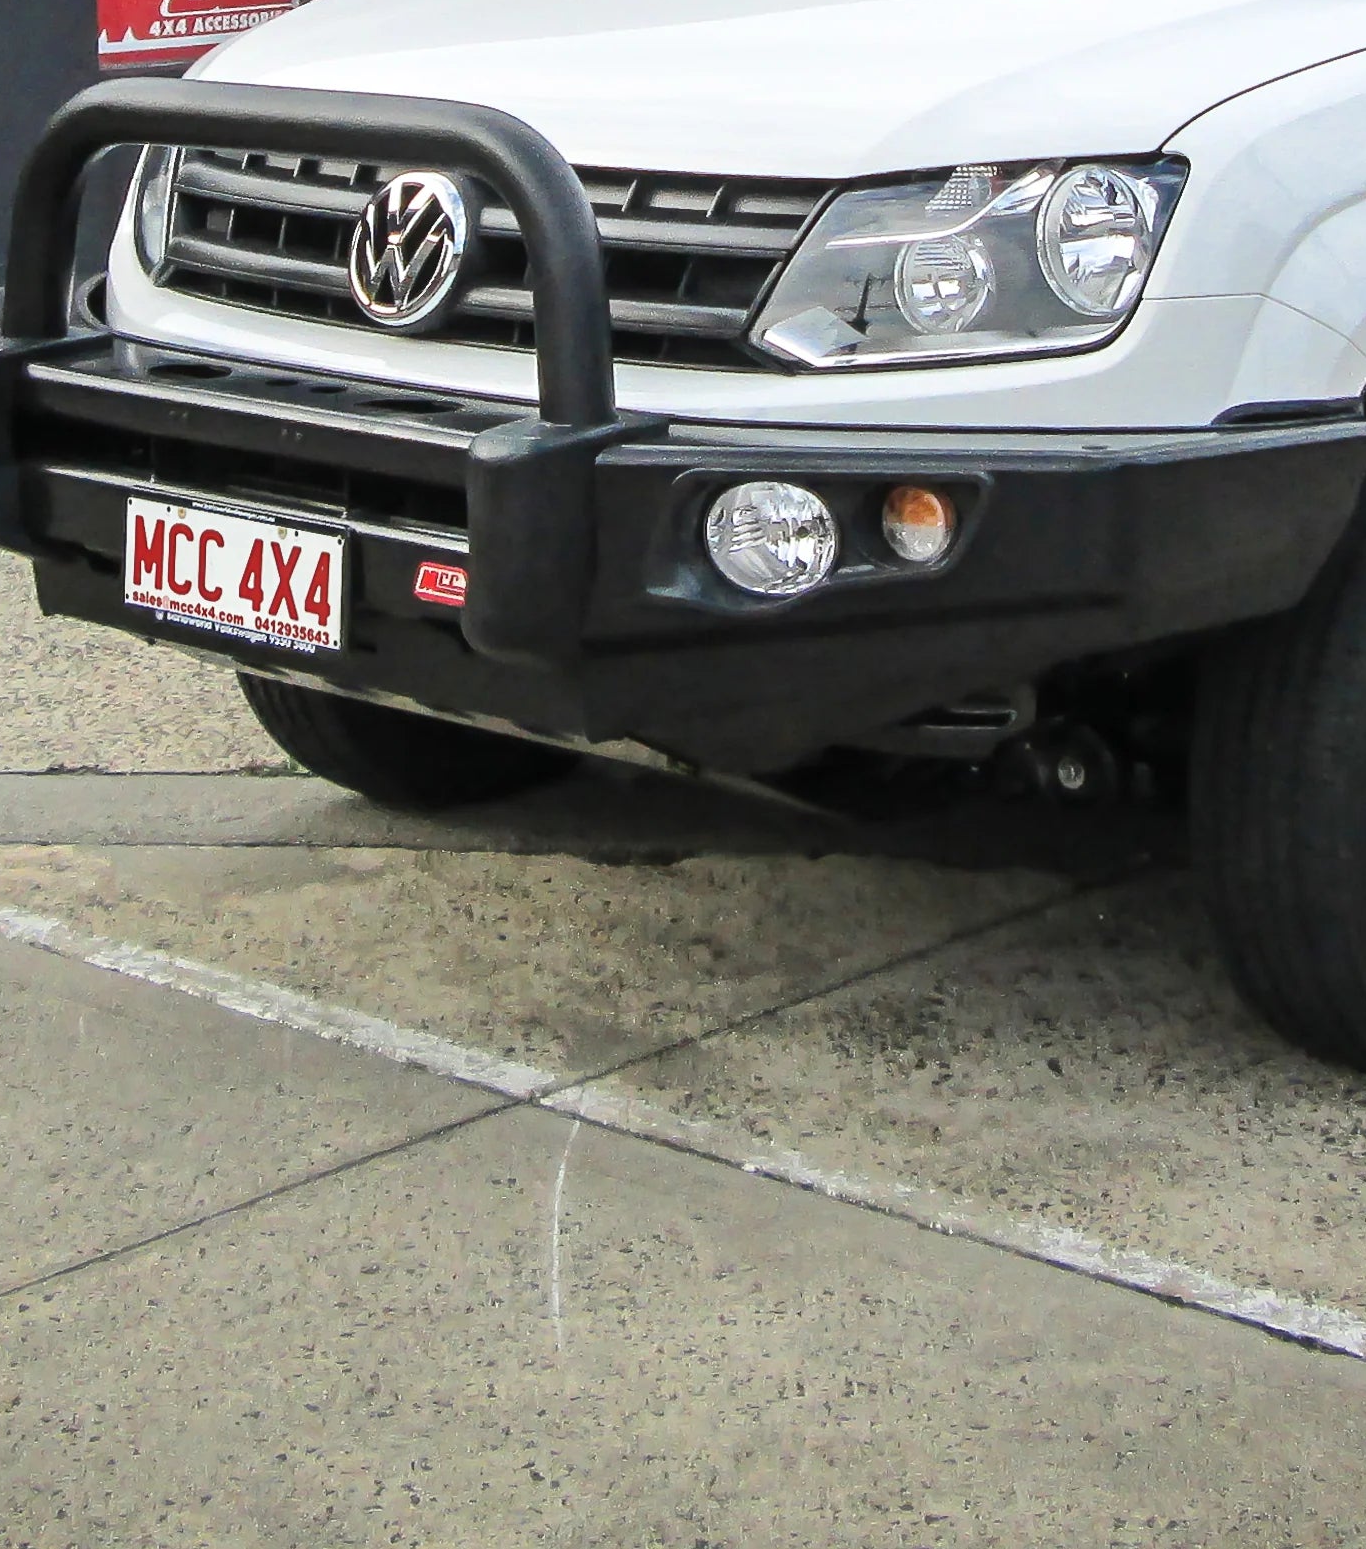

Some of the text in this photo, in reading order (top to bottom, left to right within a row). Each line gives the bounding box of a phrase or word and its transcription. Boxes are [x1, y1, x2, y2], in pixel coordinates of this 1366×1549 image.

[149, 19, 188, 37] 4X4
[133, 515, 331, 627] MCC 4X4
[419, 569, 465, 591] MCC
[255, 615, 330, 646] 0412935643
